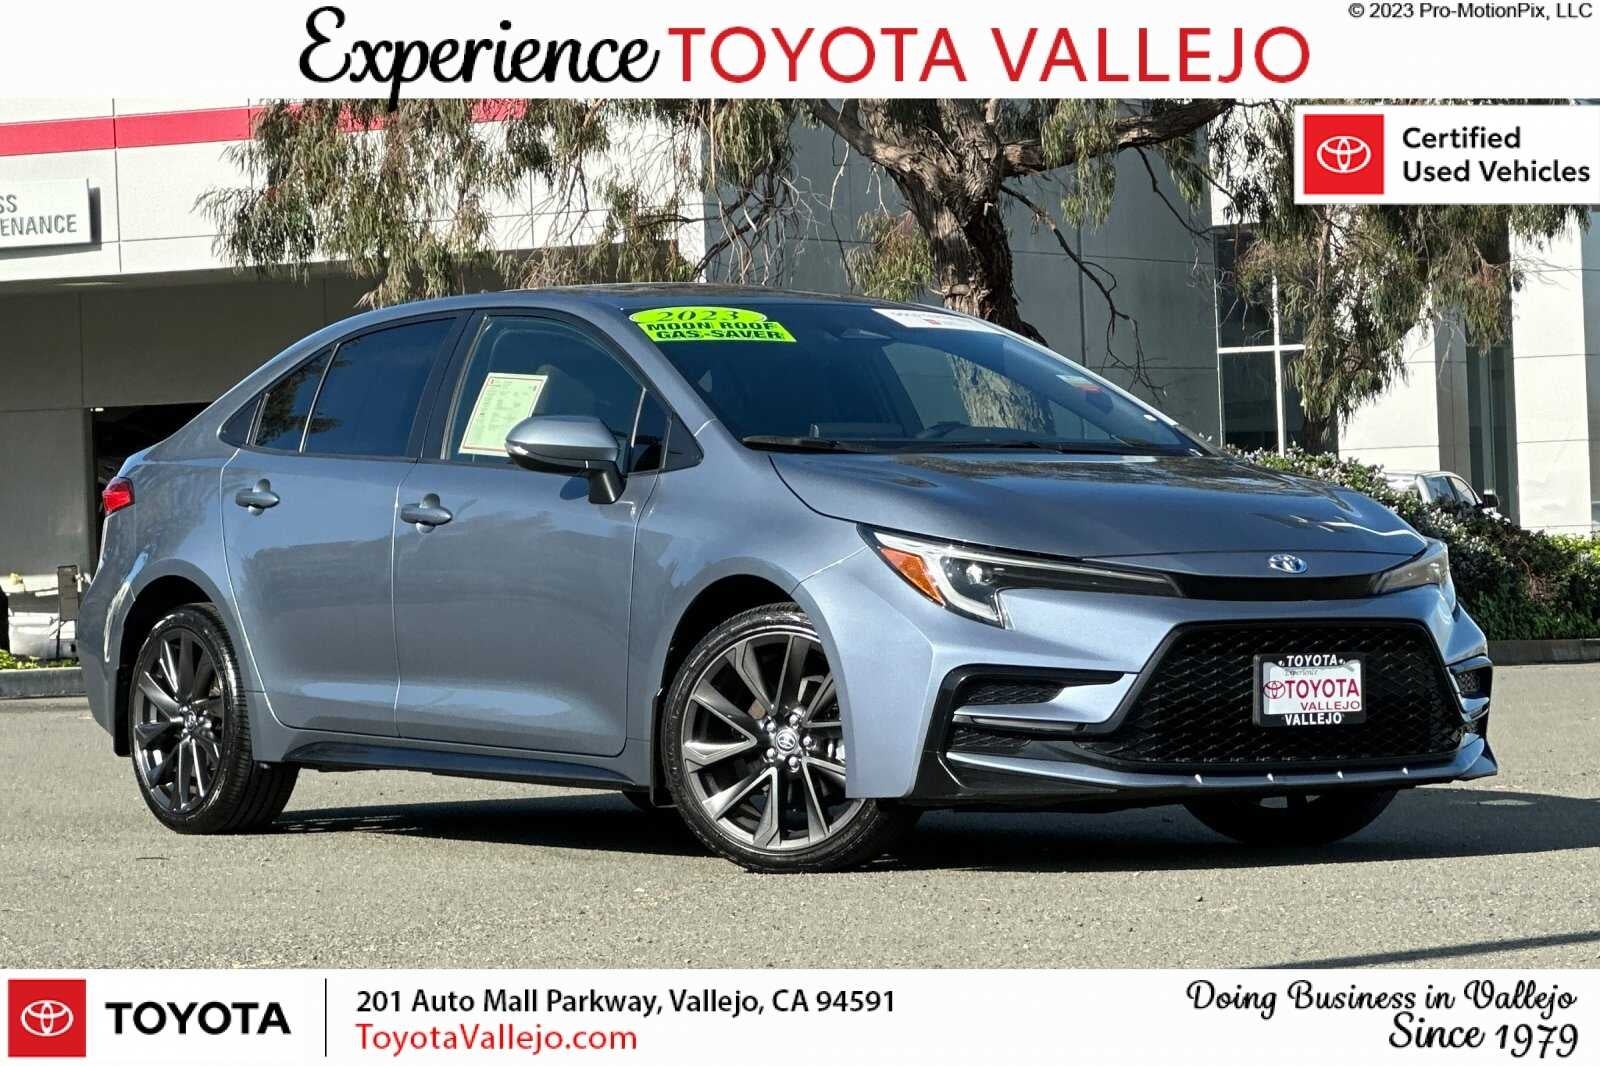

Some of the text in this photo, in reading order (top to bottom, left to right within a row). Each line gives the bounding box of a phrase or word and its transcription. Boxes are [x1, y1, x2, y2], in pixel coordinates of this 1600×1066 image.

[0, 214, 77, 236] ENANCE
[657, 310, 739, 321] 2023
[647, 321, 776, 331] MOON ROOF
[1286, 654, 1338, 667] TOYOTA
[1285, 678, 1360, 699] TOYOTA
[1300, 700, 1360, 711] VALLEJO
[1285, 712, 1342, 726] VALLEJO
